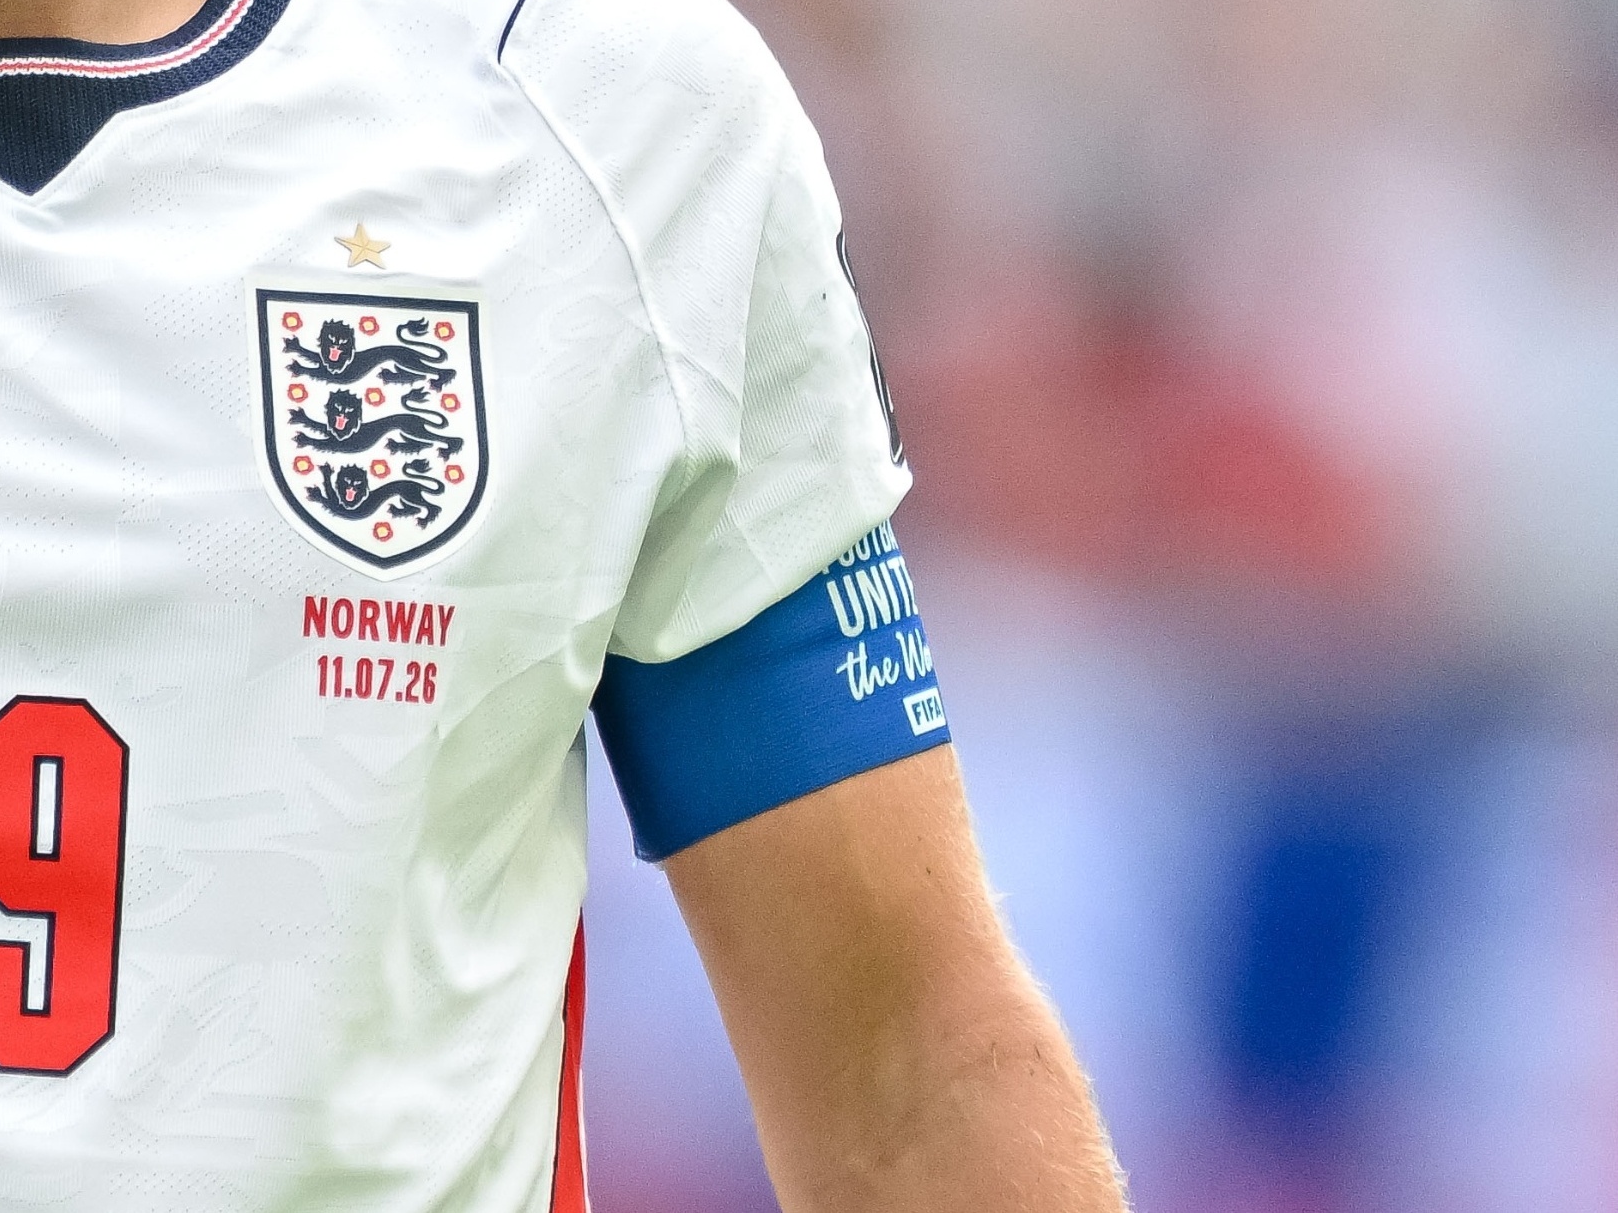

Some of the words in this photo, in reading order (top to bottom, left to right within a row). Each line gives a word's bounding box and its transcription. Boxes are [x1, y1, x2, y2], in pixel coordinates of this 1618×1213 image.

[302, 595, 456, 647] NORWAY
[317, 654, 437, 705] 11.07.26
[835, 640, 900, 701] the
[911, 695, 943, 726] FIFA
